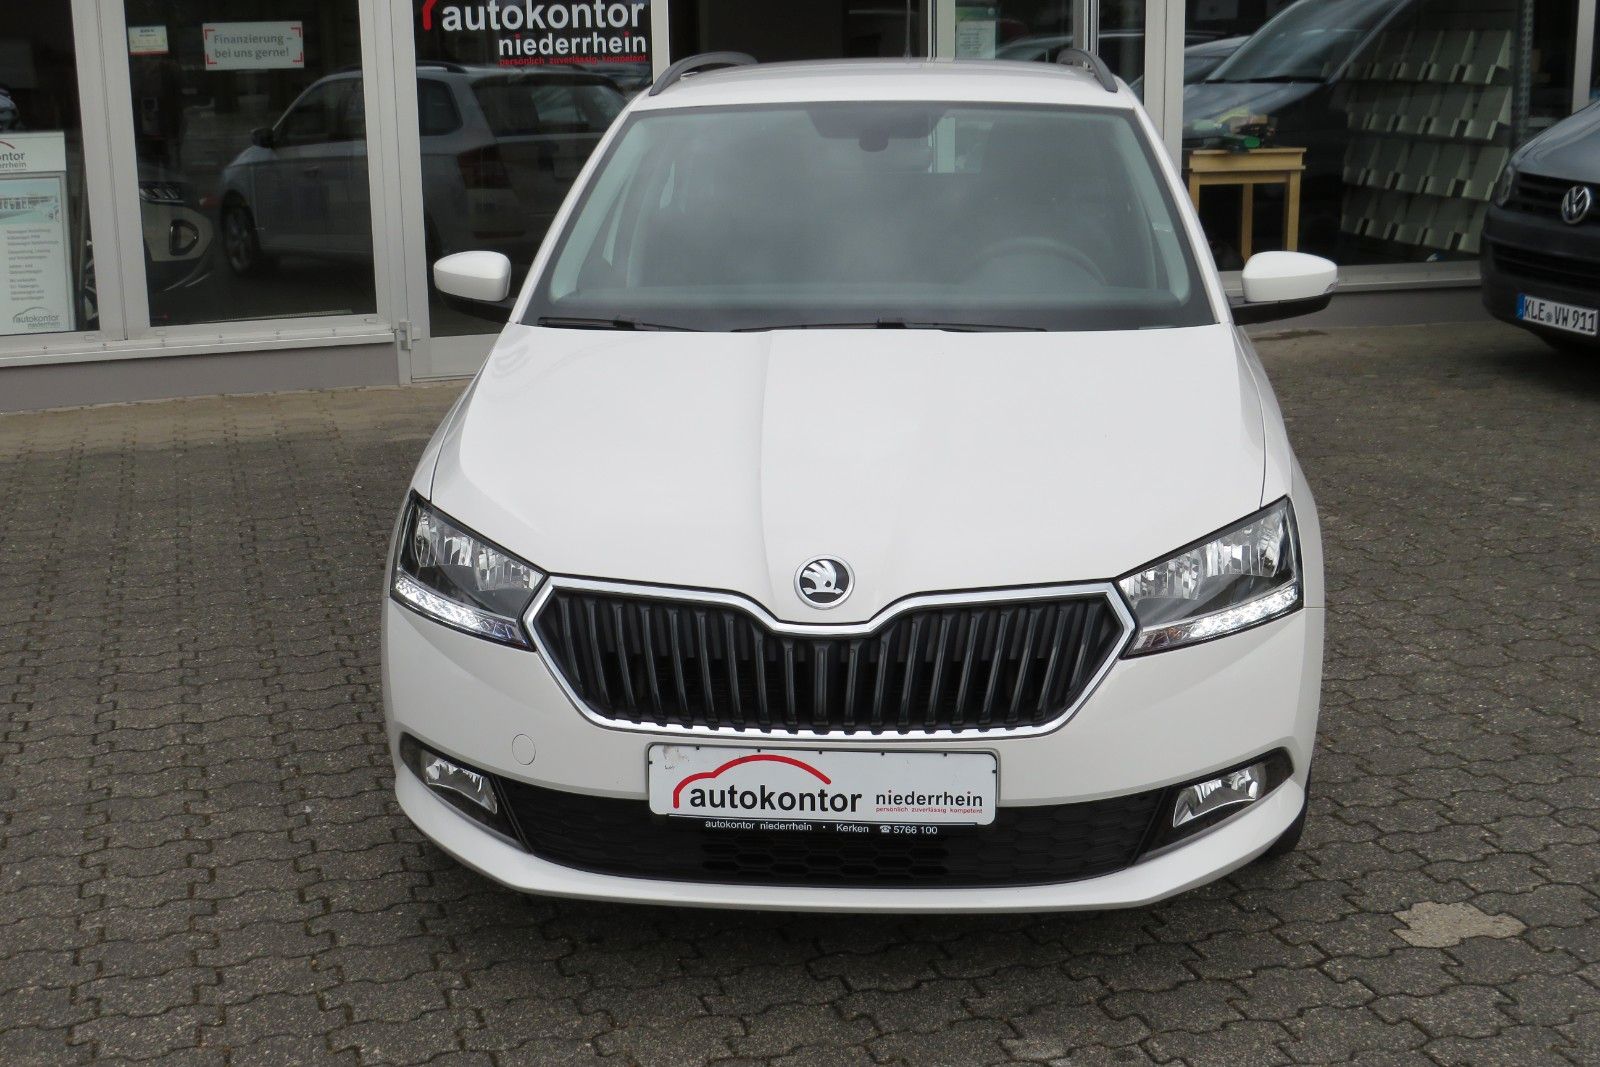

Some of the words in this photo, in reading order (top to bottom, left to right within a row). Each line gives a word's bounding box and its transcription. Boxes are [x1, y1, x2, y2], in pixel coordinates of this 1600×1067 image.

[442, 0, 645, 31] autokontor
[214, 32, 284, 45] Finanzierung
[499, 31, 647, 56] niederrhein
[215, 48, 231, 58] bei
[234, 49, 253, 58] uns
[255, 47, 289, 60] gerne!
[0, 152, 26, 161] ntor
[1524, 299, 1545, 322] KLE
[1555, 305, 1570, 327] VW
[1572, 310, 1596, 333] 911
[689, 785, 863, 812] autokontor
[875, 789, 983, 807] niederrhein
[949, 807, 983, 815] kompetent
[705, 820, 756, 830] autokontor
[760, 821, 812, 832] niederrhein
[836, 824, 869, 834] Kerken
[893, 825, 917, 835] 5766
[920, 826, 938, 836] 100
